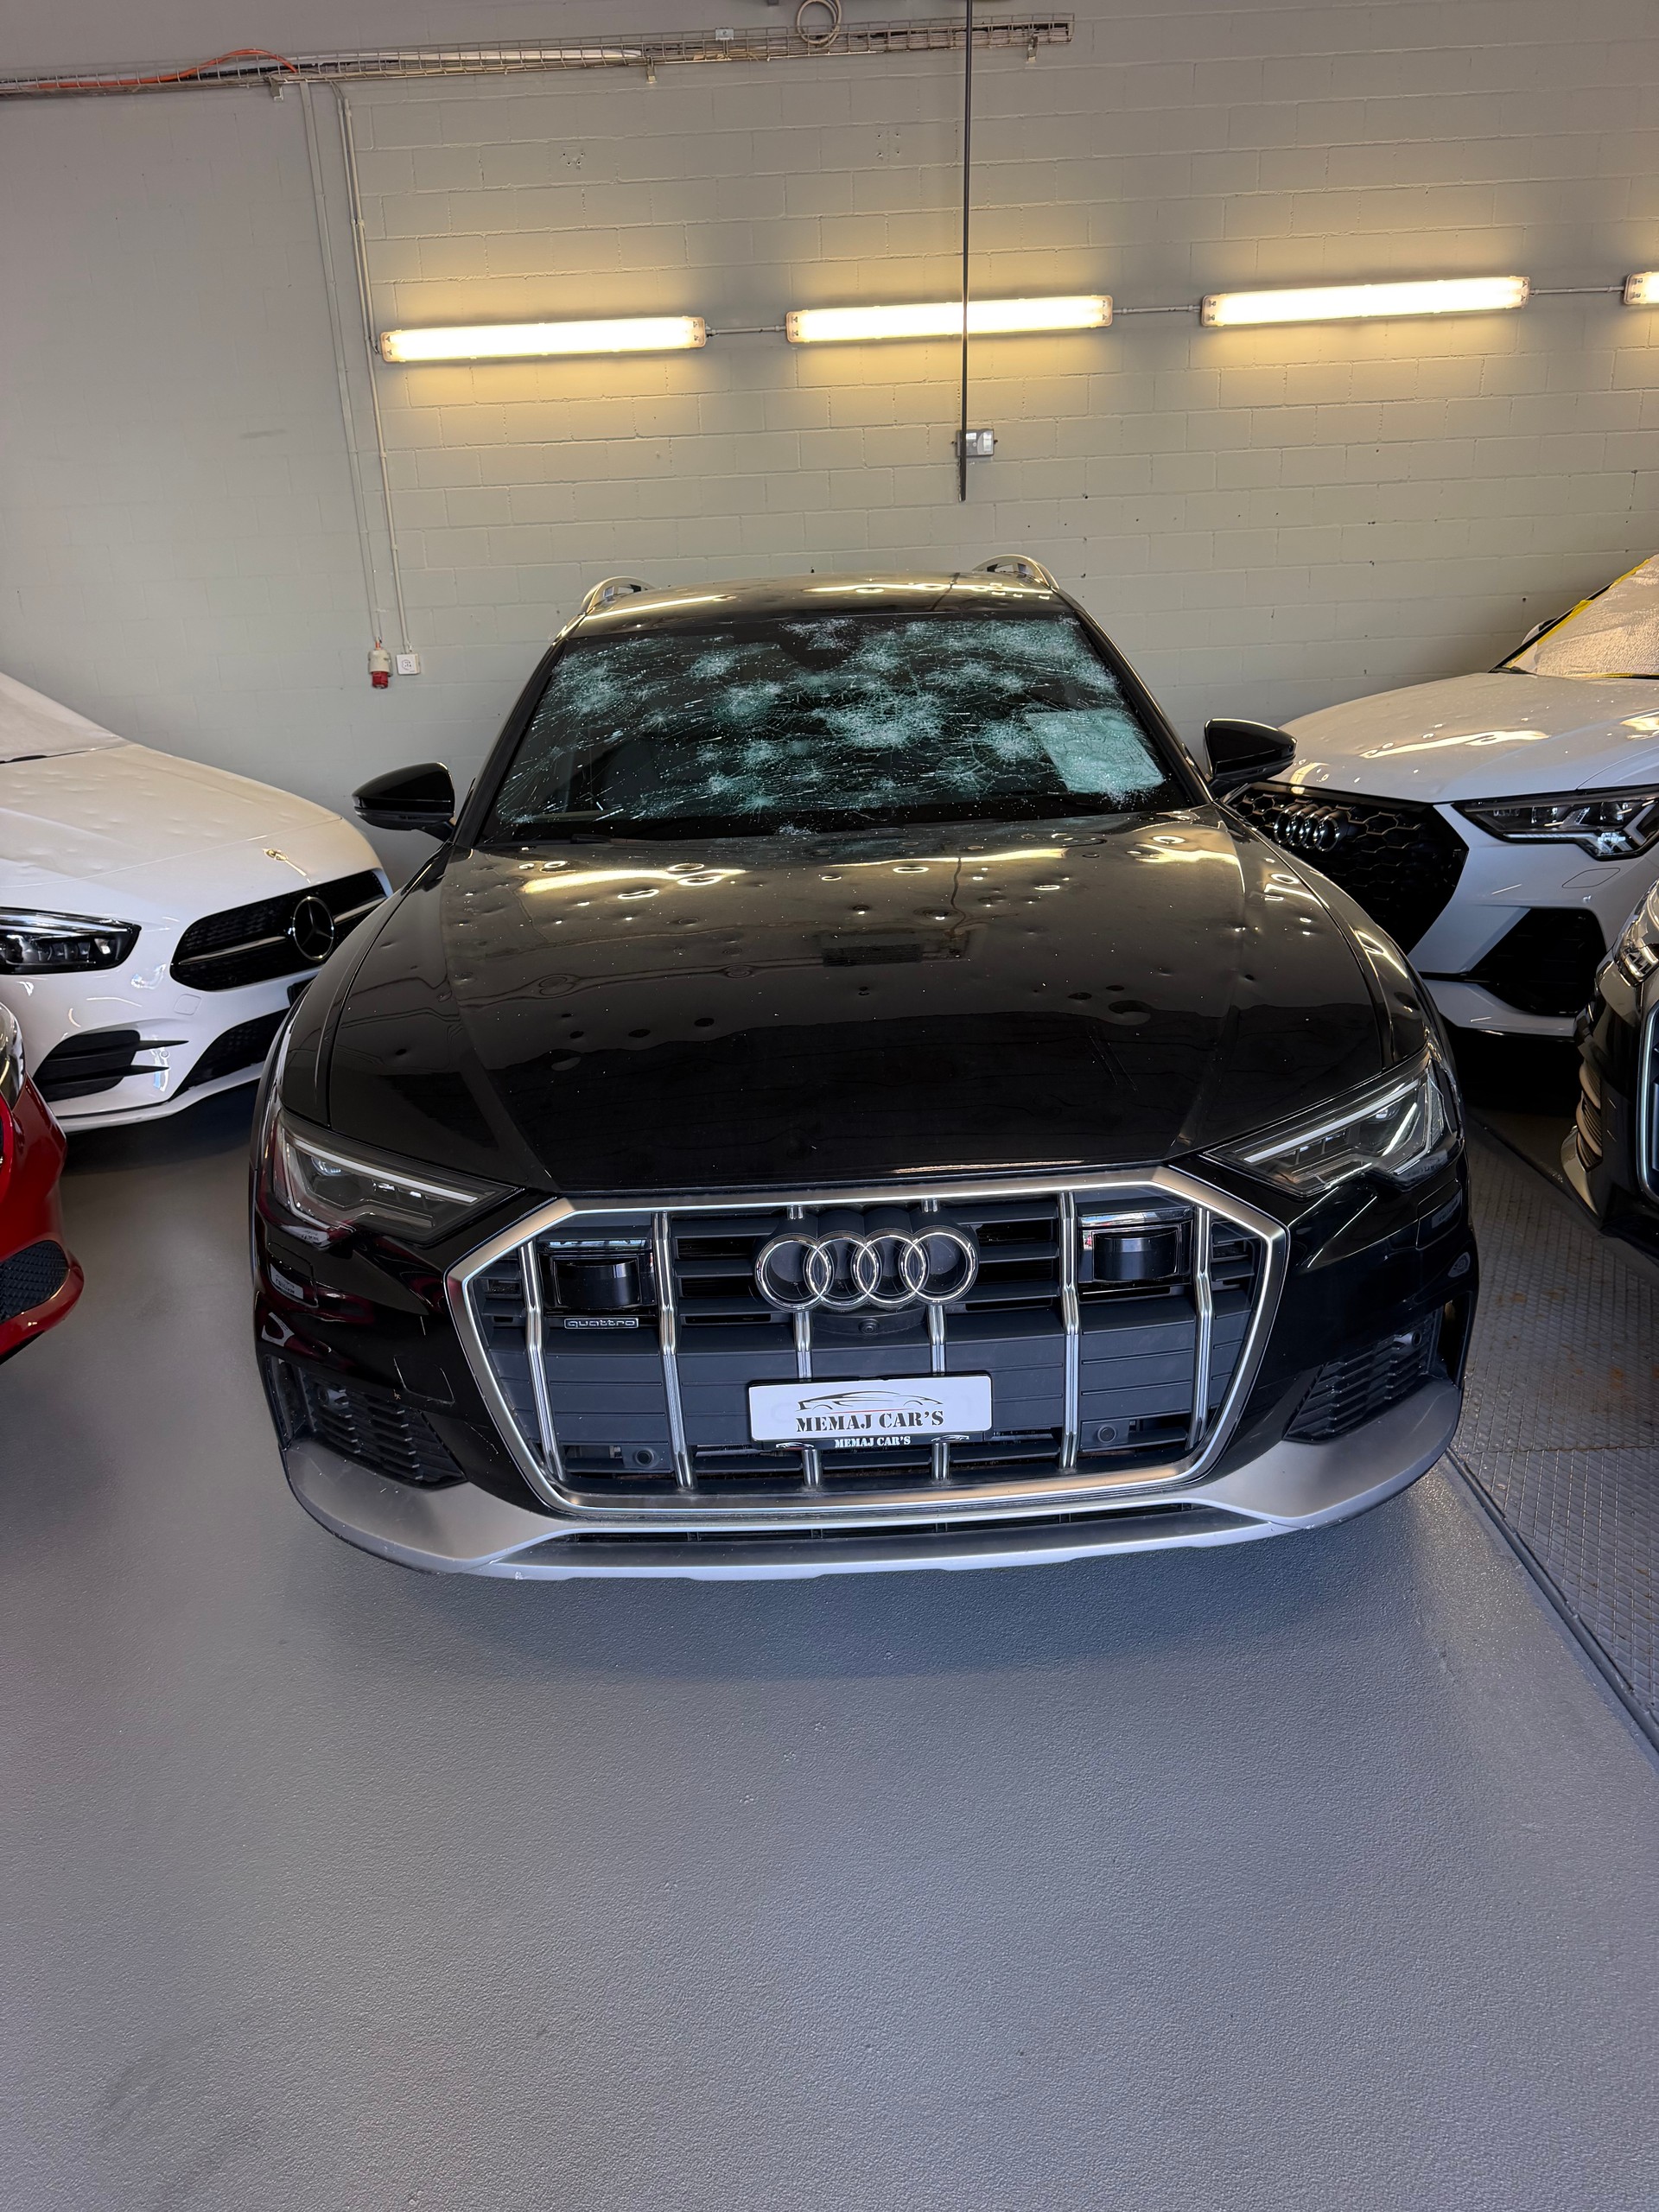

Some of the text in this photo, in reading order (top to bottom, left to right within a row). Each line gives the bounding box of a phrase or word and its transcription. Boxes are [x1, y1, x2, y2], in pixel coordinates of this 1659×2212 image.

[568, 1319, 635, 1328] quattro
[796, 1410, 944, 1433] MEMAJ CAR'S
[834, 1435, 911, 1448] MEMAJ CAR'S
